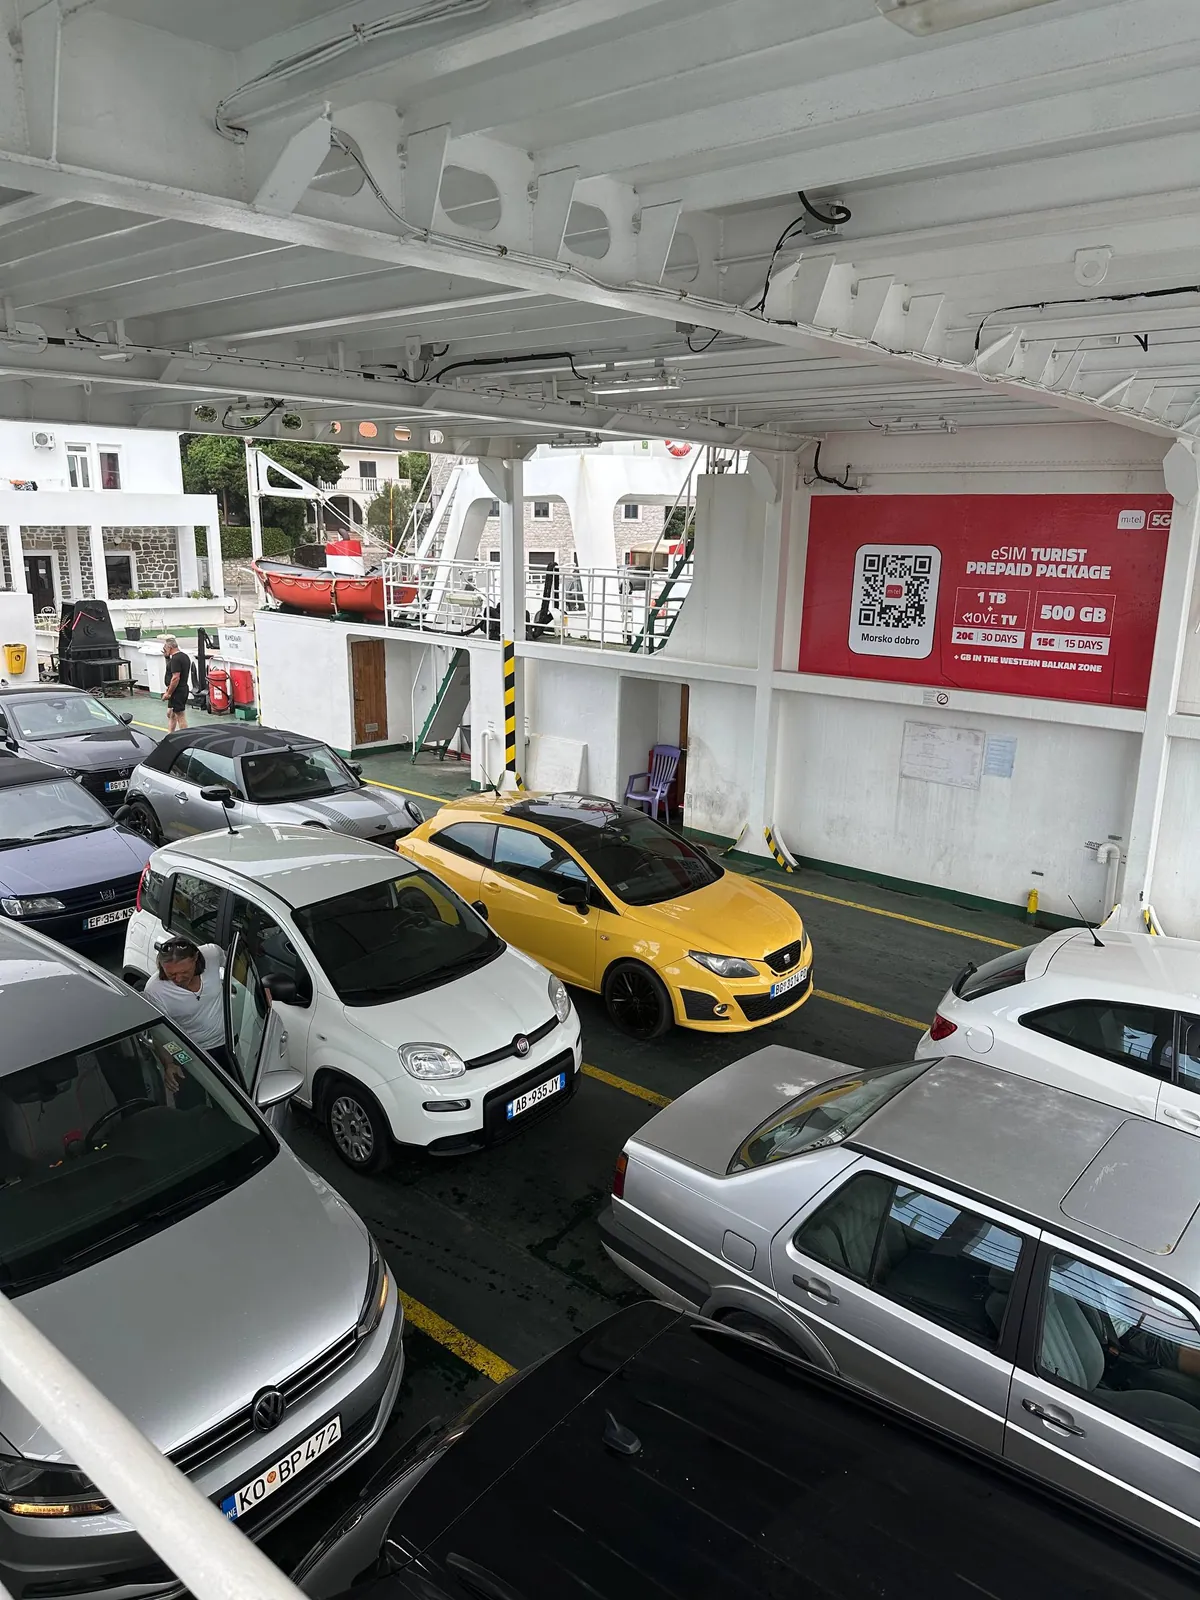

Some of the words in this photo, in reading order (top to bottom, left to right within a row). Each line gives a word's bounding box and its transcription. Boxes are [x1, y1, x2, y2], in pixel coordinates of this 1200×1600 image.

[1151, 514, 1171, 527] 5G
[991, 546, 1027, 561] eSIM
[1031, 547, 1088, 563] TURIST
[966, 561, 1033, 577] PREPAID
[1036, 564, 1112, 580] PACKAGE
[977, 591, 985, 604] 1
[988, 592, 1007, 605] TB
[1001, 614, 1018, 626] TV
[1040, 604, 1076, 621] 500
[1080, 606, 1107, 623] GB
[861, 632, 893, 644] Morsko
[894, 635, 920, 646] dobro
[956, 631, 975, 641] 20€
[980, 632, 993, 642] 30
[994, 633, 1018, 644] DAYS
[1036, 637, 1056, 647] 15€
[1064, 639, 1076, 649] 15
[1077, 640, 1104, 651] DAYS
[960, 653, 972, 661] GB
[972, 654, 982, 662] IN
[983, 655, 999, 664] THE
[1000, 656, 1041, 668] WESTERN
[1041, 659, 1077, 671] BALKAN
[1078, 663, 1103, 673] ZONE
[239, 1478, 266, 1512] KO
